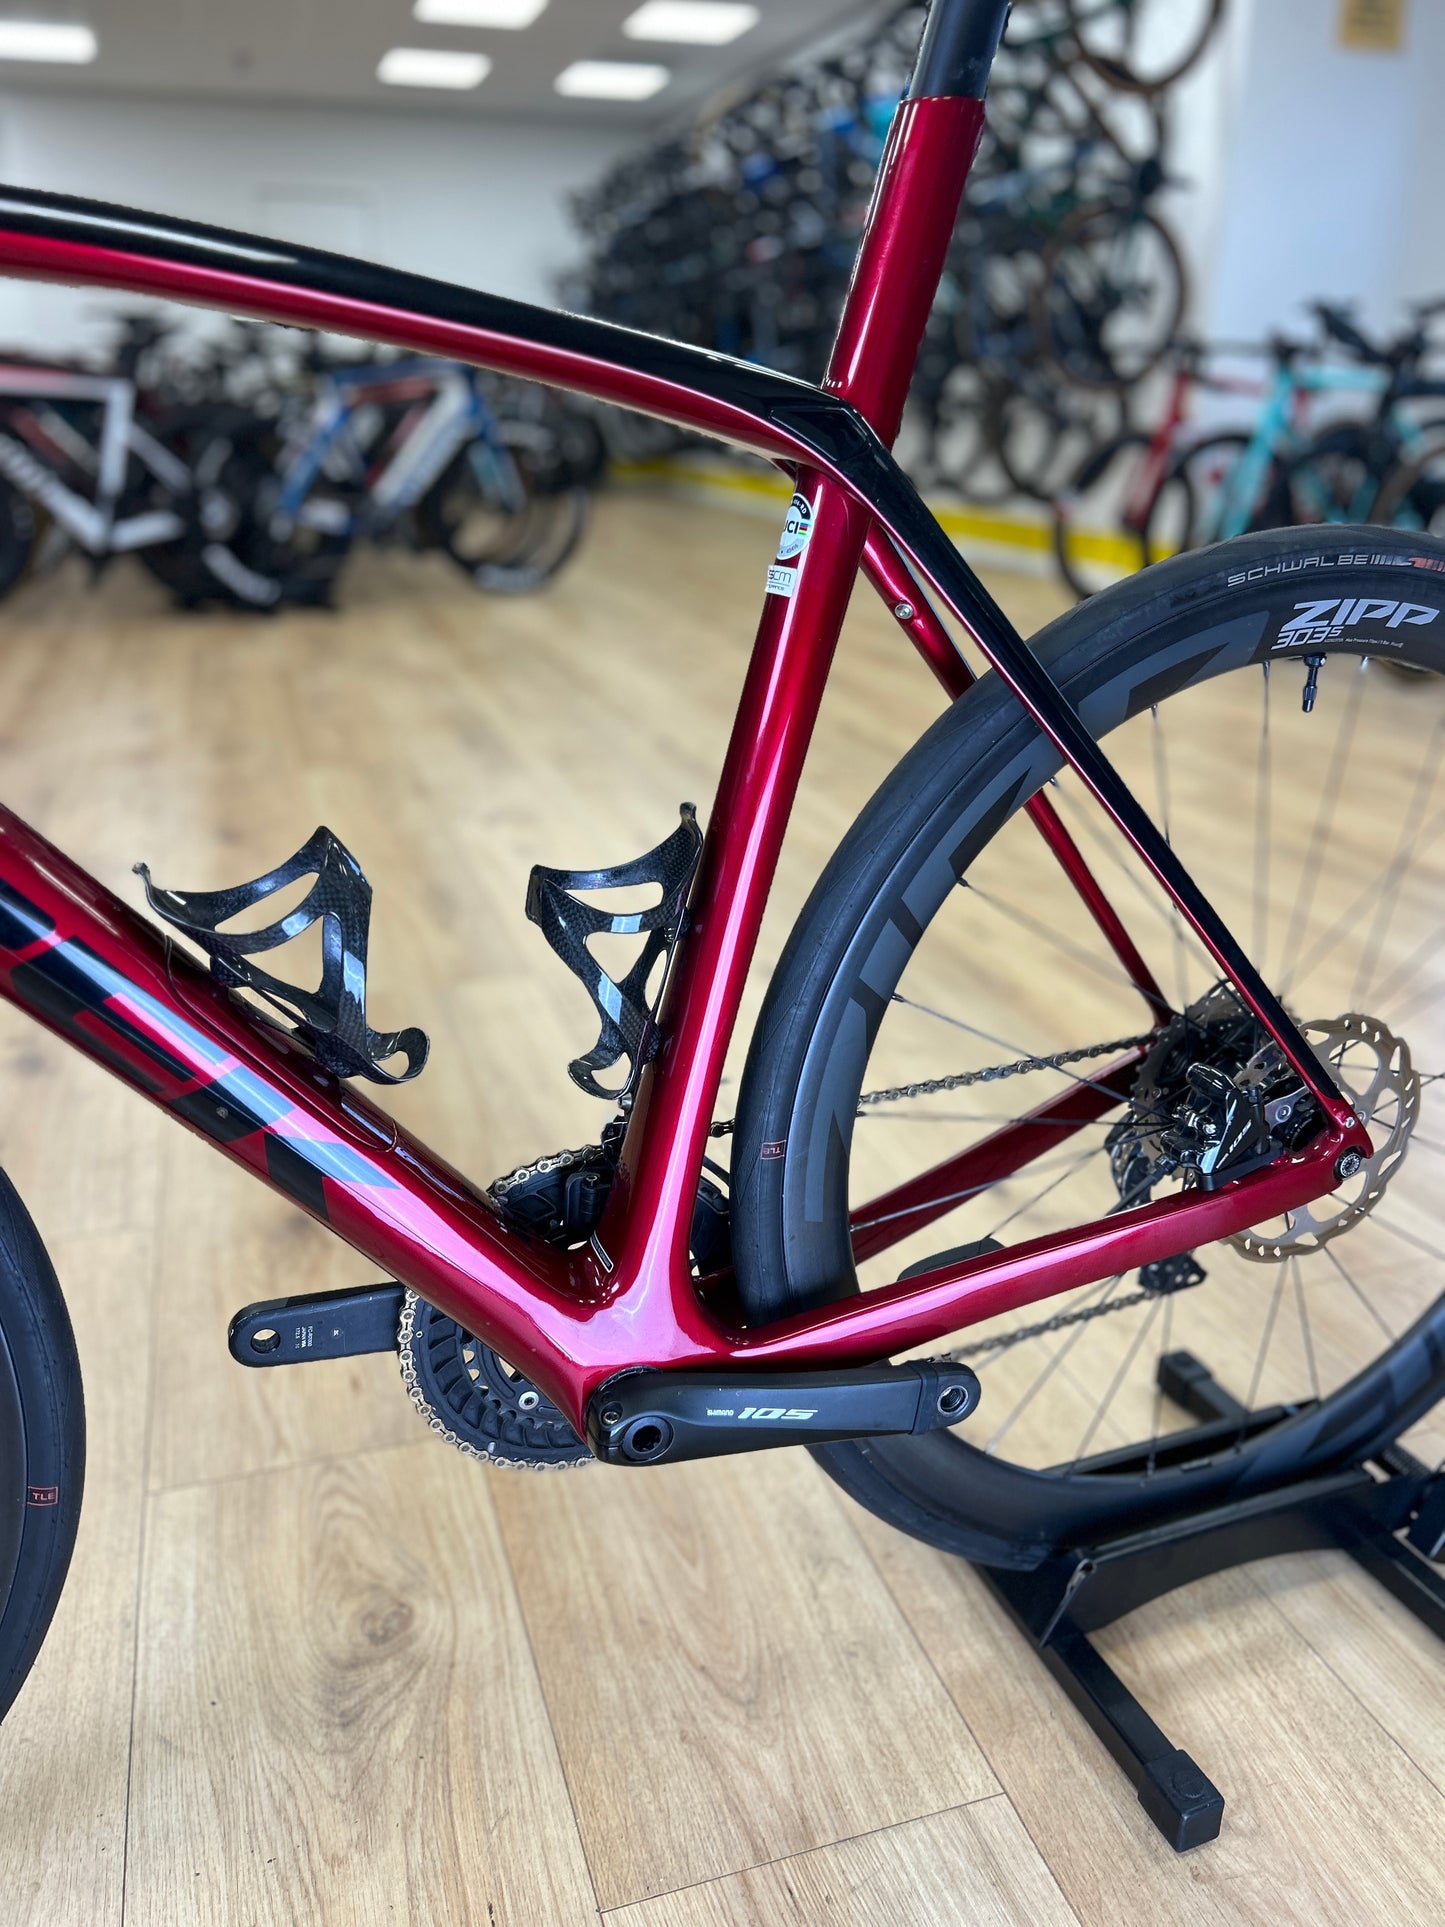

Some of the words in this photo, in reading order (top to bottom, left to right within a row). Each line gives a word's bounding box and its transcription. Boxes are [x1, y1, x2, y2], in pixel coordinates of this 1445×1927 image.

[1227, 554, 1367, 587] SCHWALBE
[1280, 598, 1440, 632] ZIPP
[737, 1407, 819, 1420] 105
[32, 1492, 55, 1500] TLE
